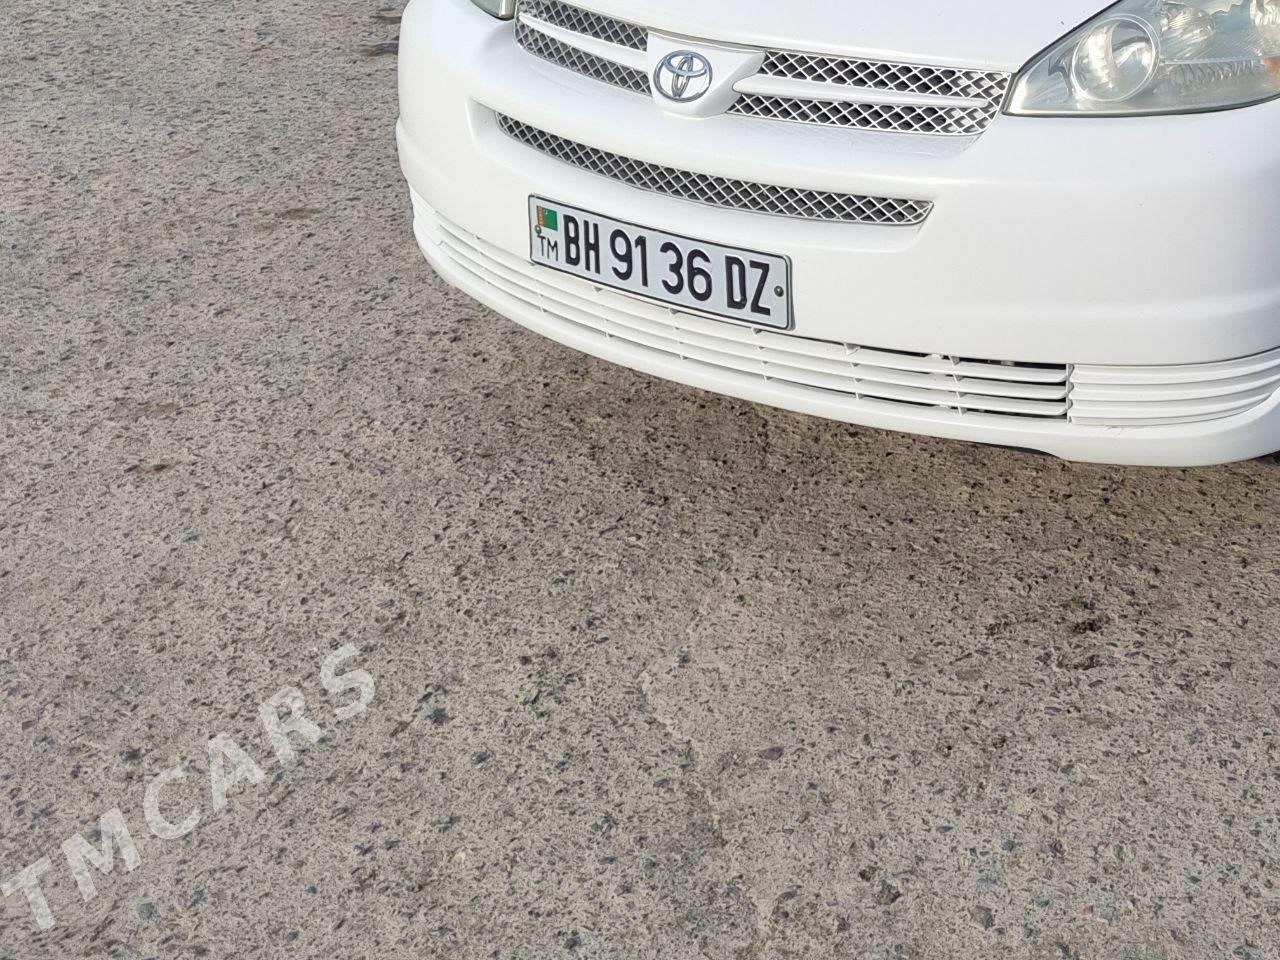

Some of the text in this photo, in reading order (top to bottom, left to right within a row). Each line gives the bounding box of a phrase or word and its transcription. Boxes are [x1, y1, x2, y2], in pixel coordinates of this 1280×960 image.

[537, 214, 771, 316] TM BH 91 36 DZ
